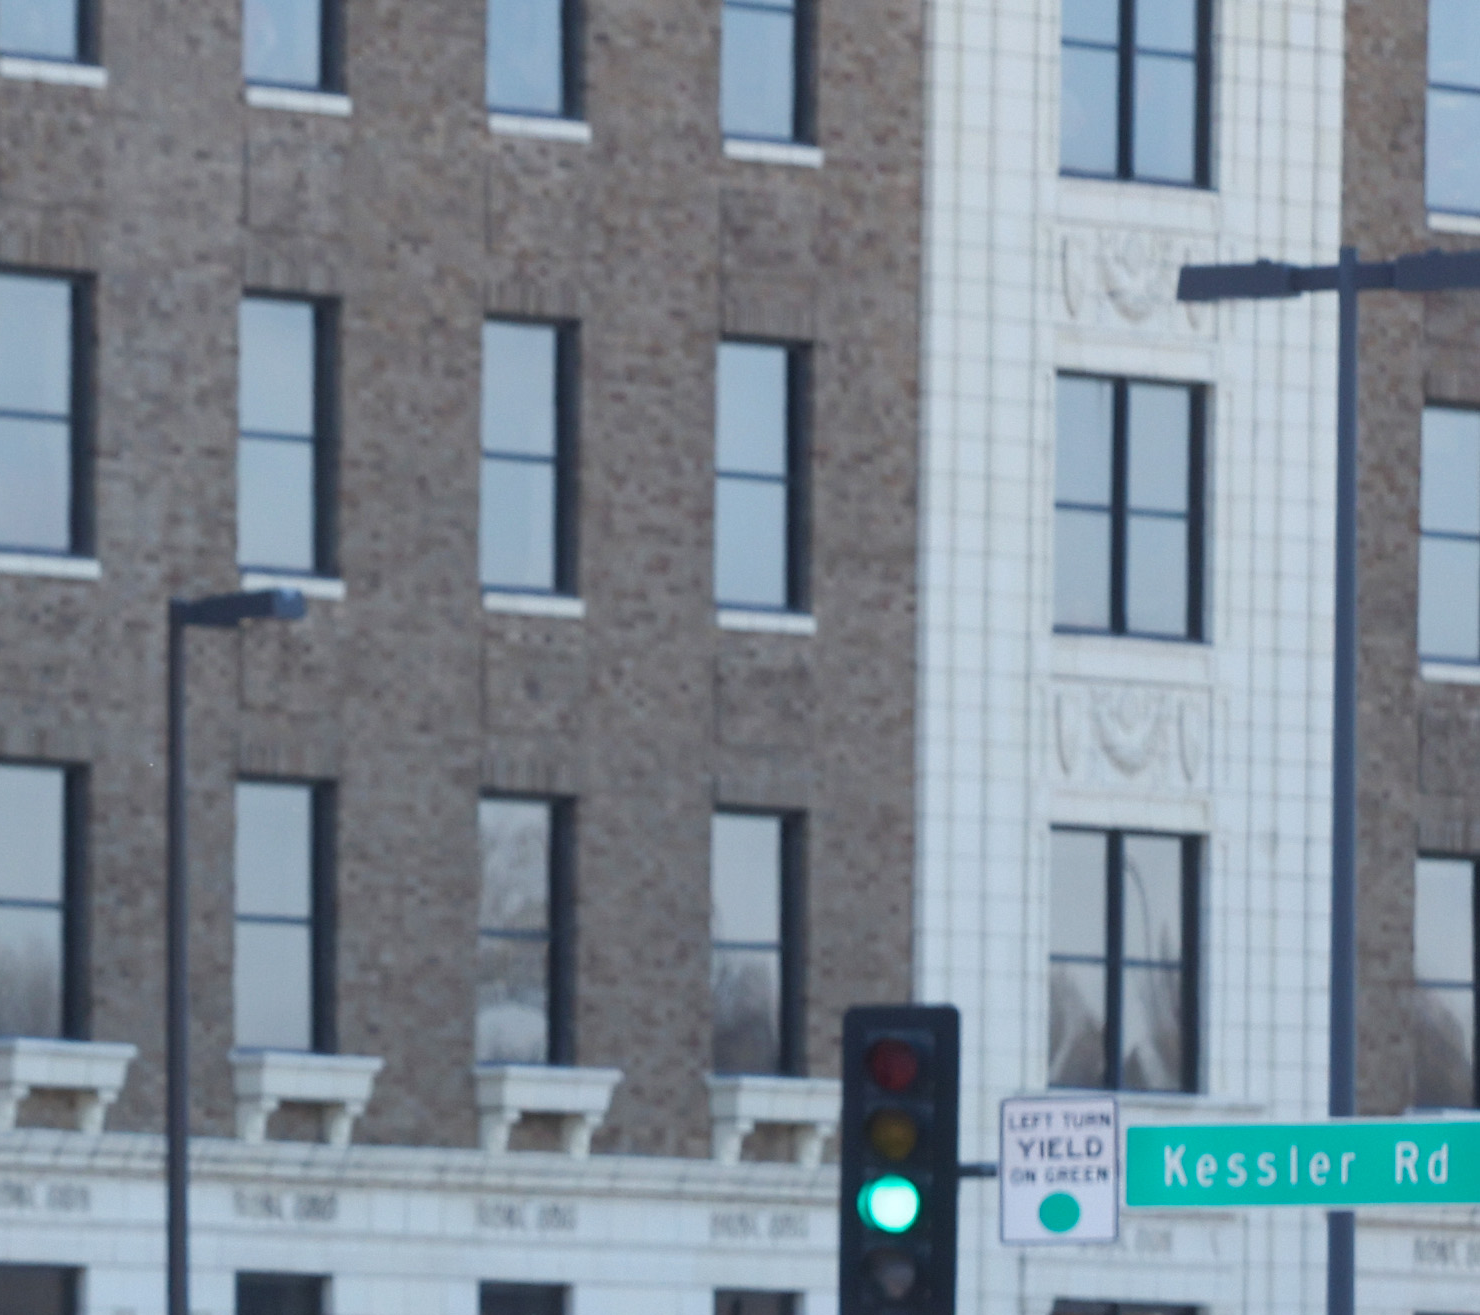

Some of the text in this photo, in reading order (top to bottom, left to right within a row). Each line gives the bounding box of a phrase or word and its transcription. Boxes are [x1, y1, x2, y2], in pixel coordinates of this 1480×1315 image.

[1008, 1111, 1112, 1131] LEFT TURN
[1017, 1135, 1103, 1160] YIELD
[1010, 1164, 1110, 1184] ON GREEN
[1163, 1140, 1449, 1188] Kessler Rd
